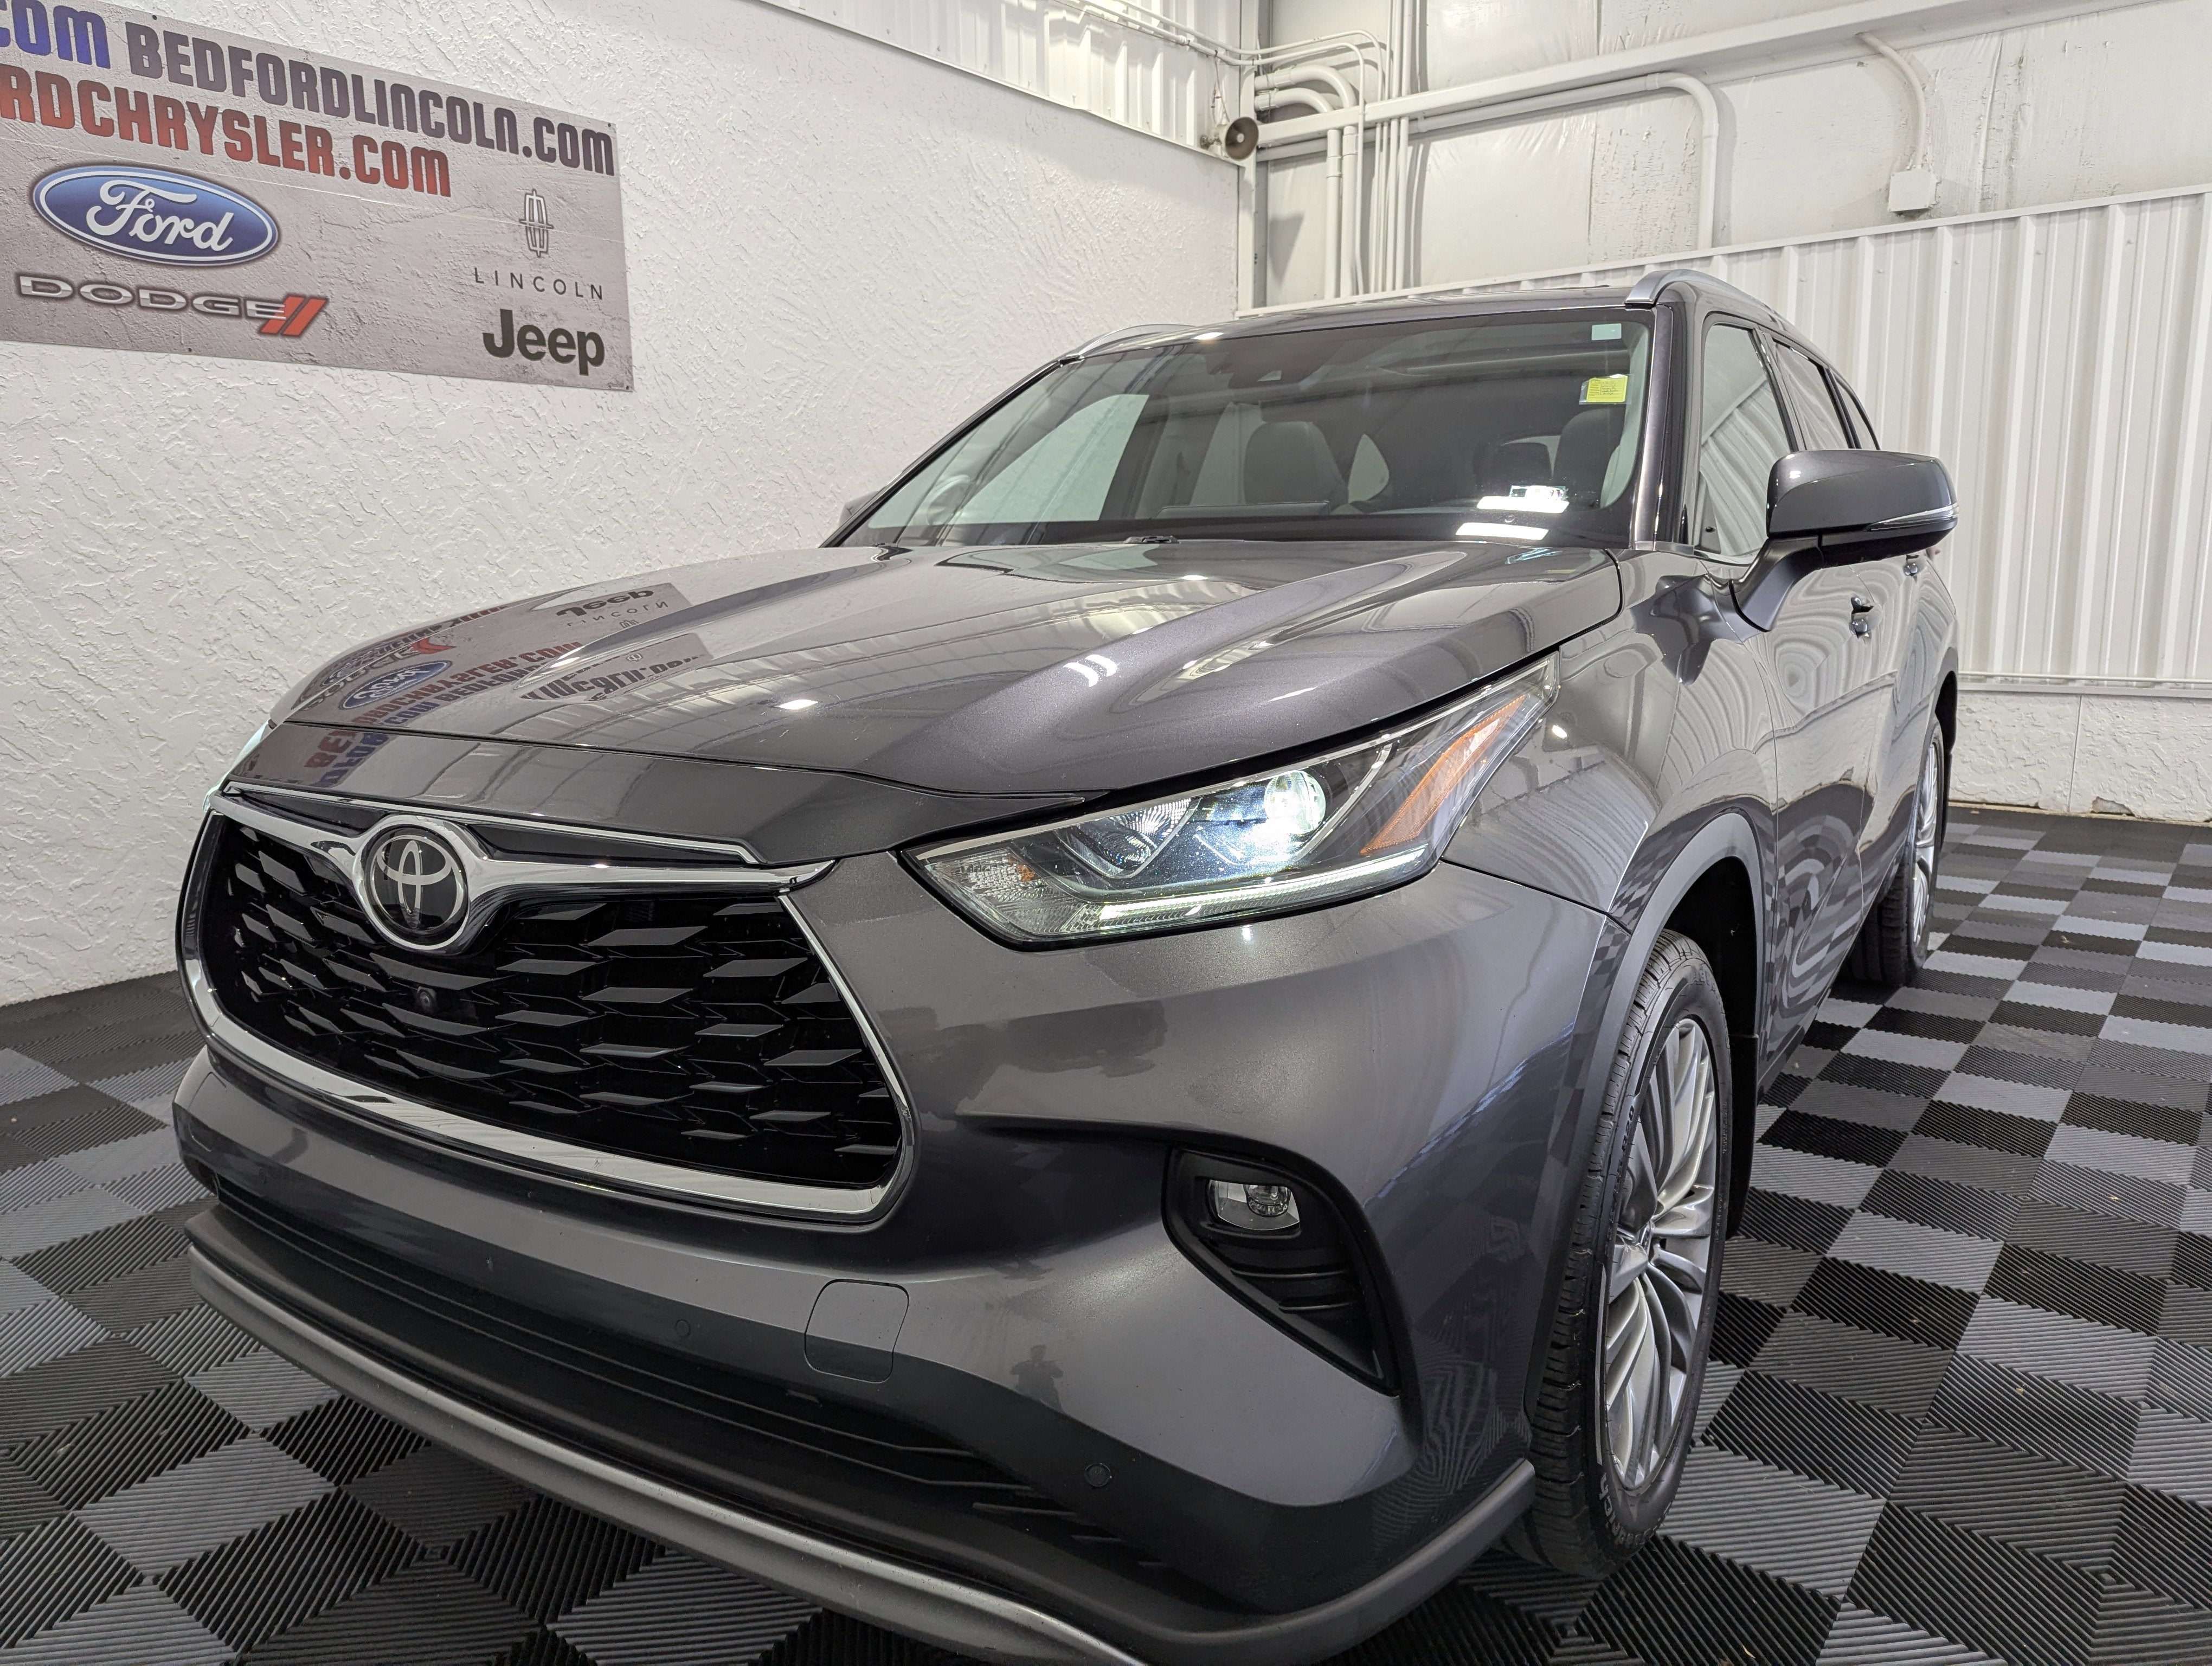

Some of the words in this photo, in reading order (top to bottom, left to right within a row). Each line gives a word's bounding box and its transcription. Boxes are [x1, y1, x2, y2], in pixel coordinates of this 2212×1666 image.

[0, 0, 111, 69] OM
[125, 21, 614, 176] BEDFORDLINCOLN.COM
[86, 180, 232, 252] Ford
[19, 275, 287, 320] DODGE
[474, 267, 603, 300] LINCOLN
[483, 309, 605, 376] Jeep
